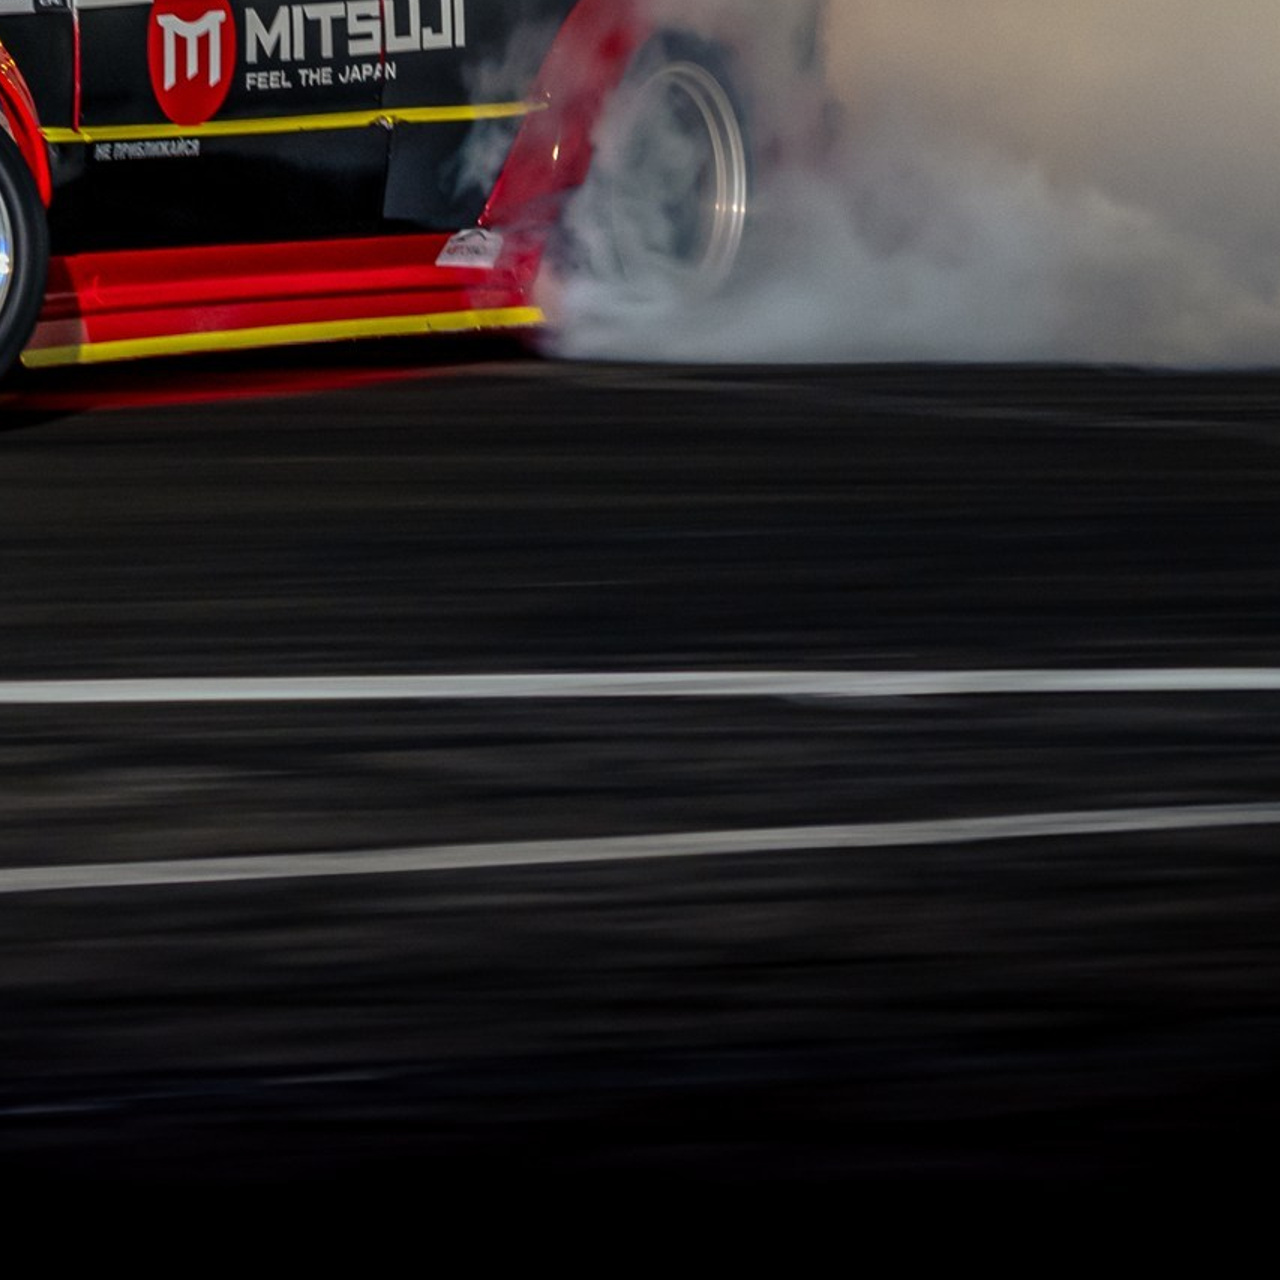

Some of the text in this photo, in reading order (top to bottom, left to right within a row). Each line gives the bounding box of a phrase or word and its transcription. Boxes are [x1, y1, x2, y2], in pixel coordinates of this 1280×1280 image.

[245, 60, 397, 91] FEEL THE JAPAN
